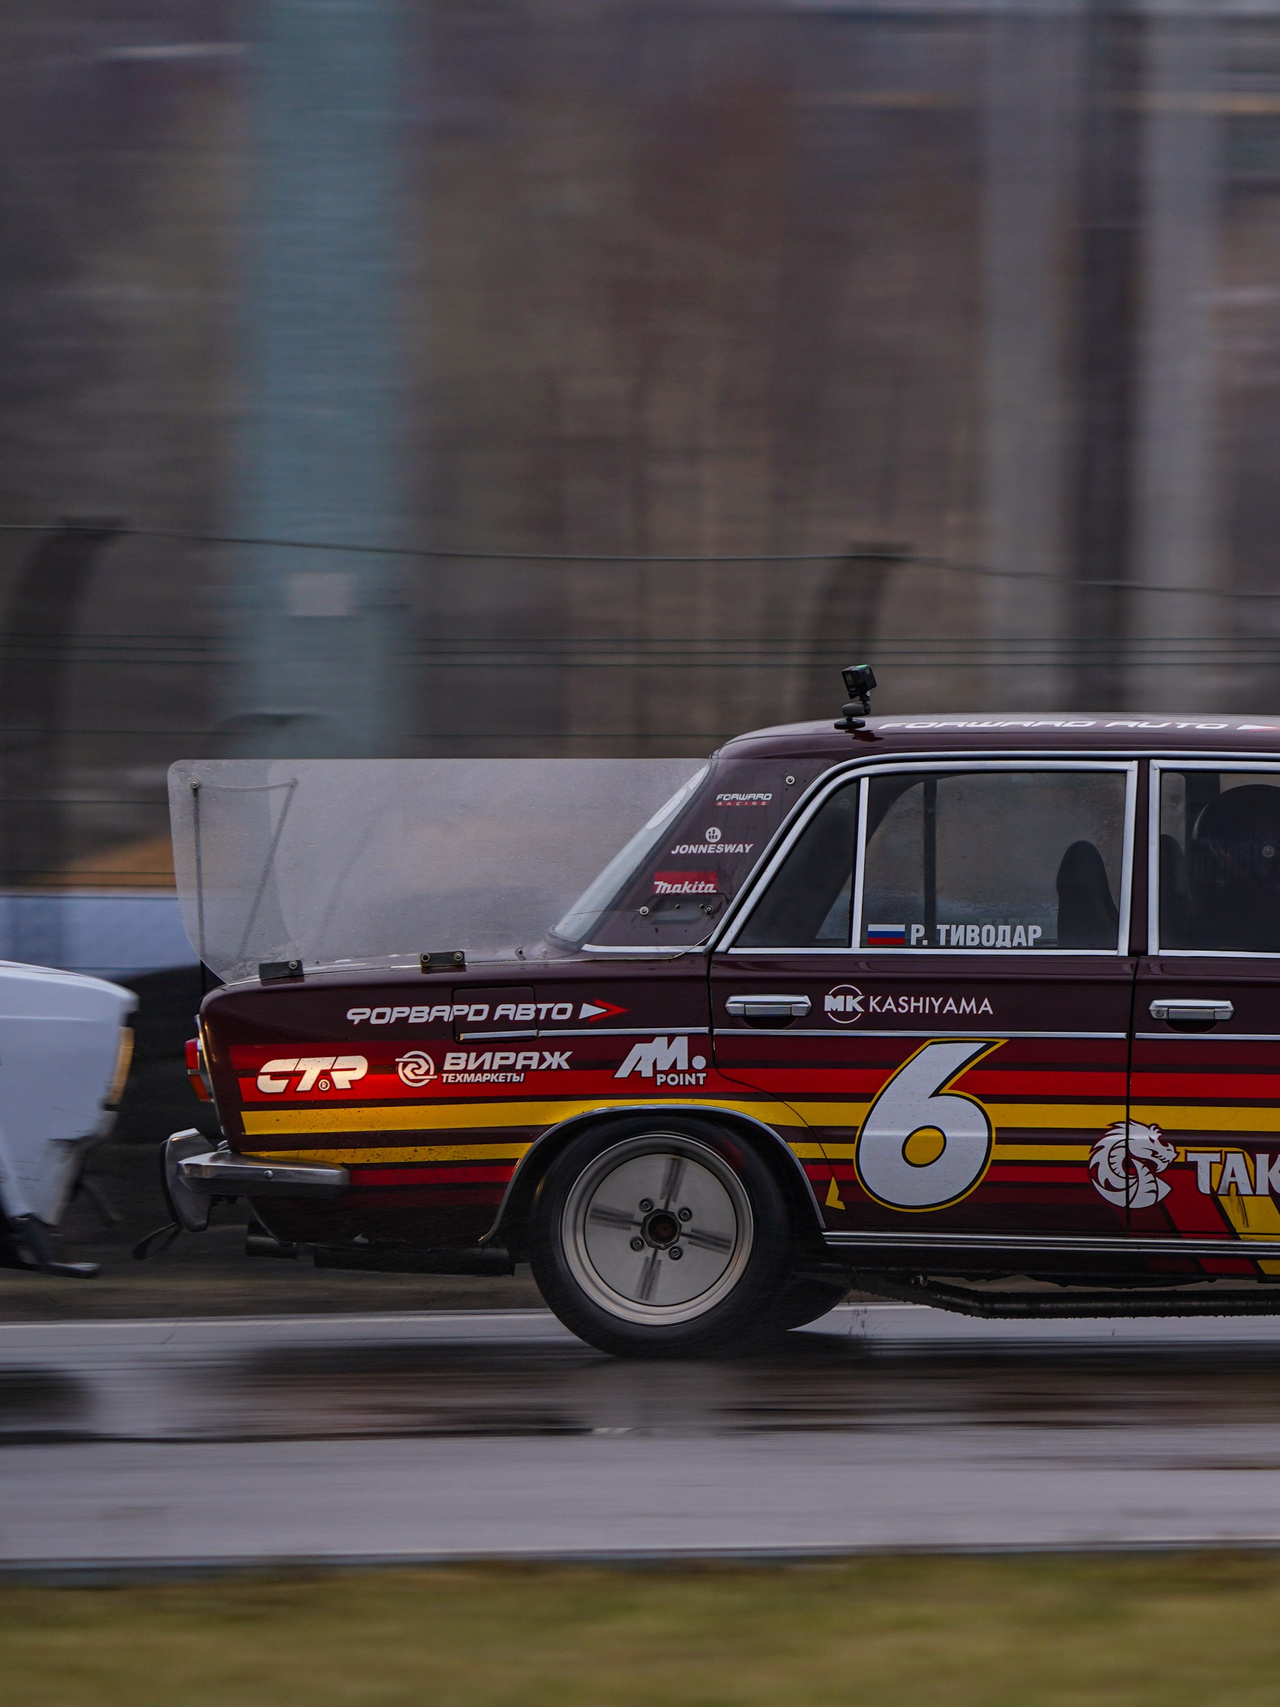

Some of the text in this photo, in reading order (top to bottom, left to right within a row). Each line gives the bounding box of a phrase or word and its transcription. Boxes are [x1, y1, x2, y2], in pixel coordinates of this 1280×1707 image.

[878, 720, 1229, 730] FORWARD AUTO
[716, 793, 773, 801] FORWARD
[671, 843, 754, 854] JONNESWAY
[910, 923, 1043, 948] Р. ТИВОДАР
[824, 995, 994, 1015] MK KASHIYAMA
[346, 1003, 573, 1025] ФОРВАРД АВТО
[443, 1051, 574, 1071] ВИРАЖ
[441, 1073, 525, 1084] ТЕХМАРКЕТЫ
[656, 1072, 707, 1086] POINT
[856, 1039, 1007, 1212] 6
